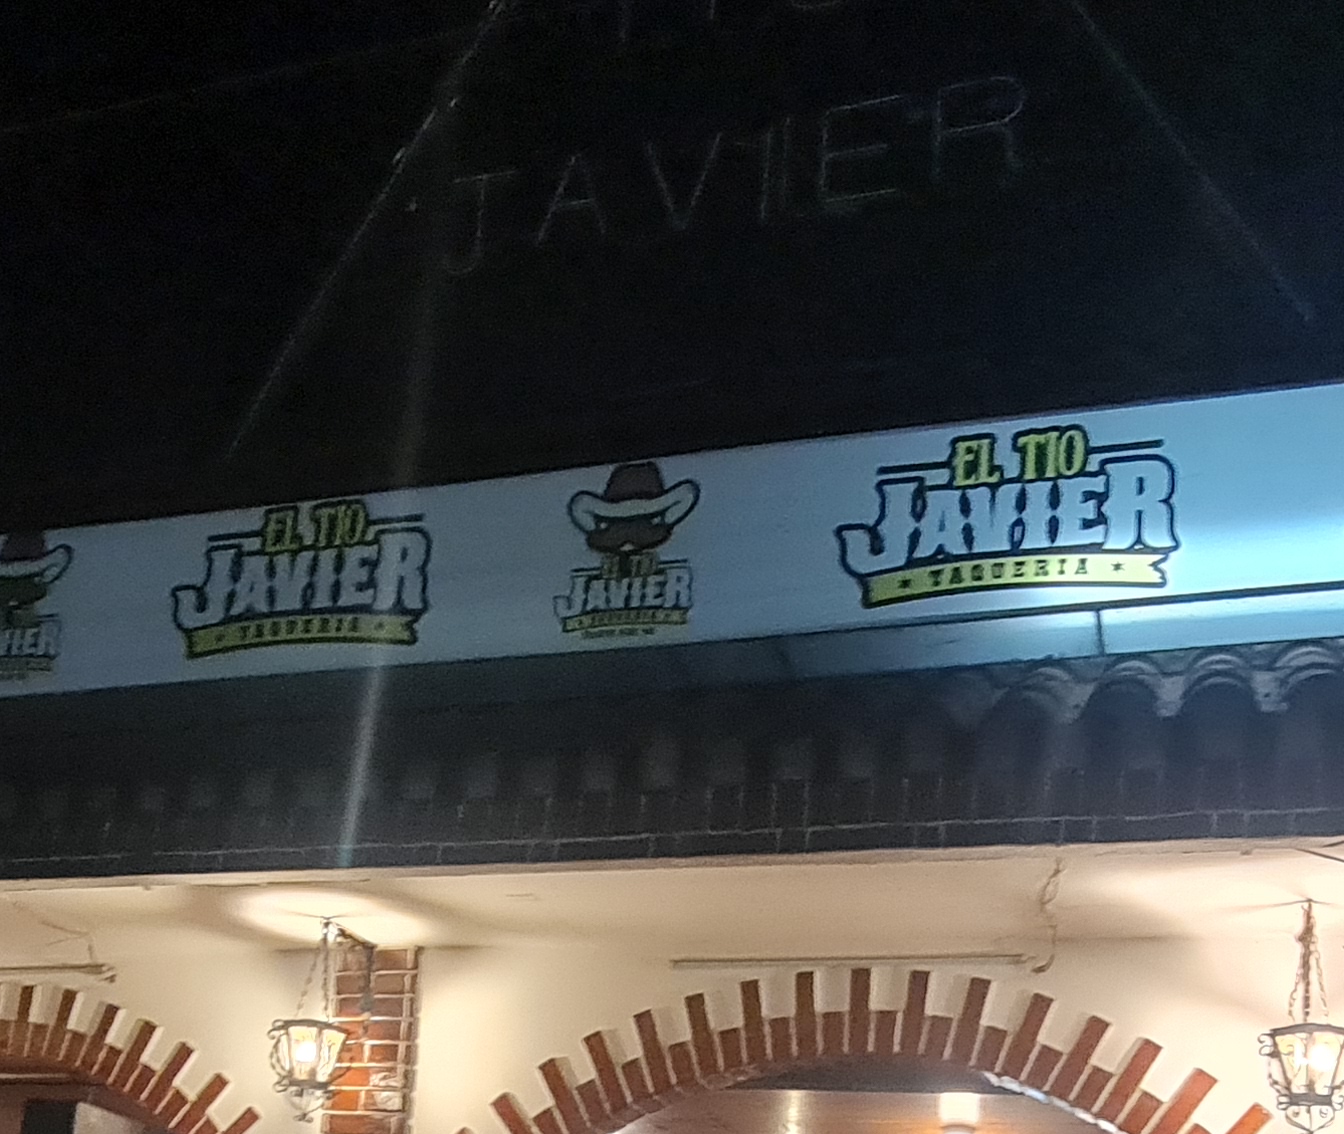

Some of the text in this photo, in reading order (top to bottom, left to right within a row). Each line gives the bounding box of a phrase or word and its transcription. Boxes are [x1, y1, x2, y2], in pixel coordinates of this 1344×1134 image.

[444, 75, 1026, 275] JAVIER
[952, 427, 1088, 488] EL TIO
[263, 501, 369, 552] EL TIO
[837, 454, 1180, 578] JAVIER
[172, 527, 432, 632] JAVIER
[553, 565, 693, 621] JAVIER
[927, 556, 1089, 588] TAQUERIA
